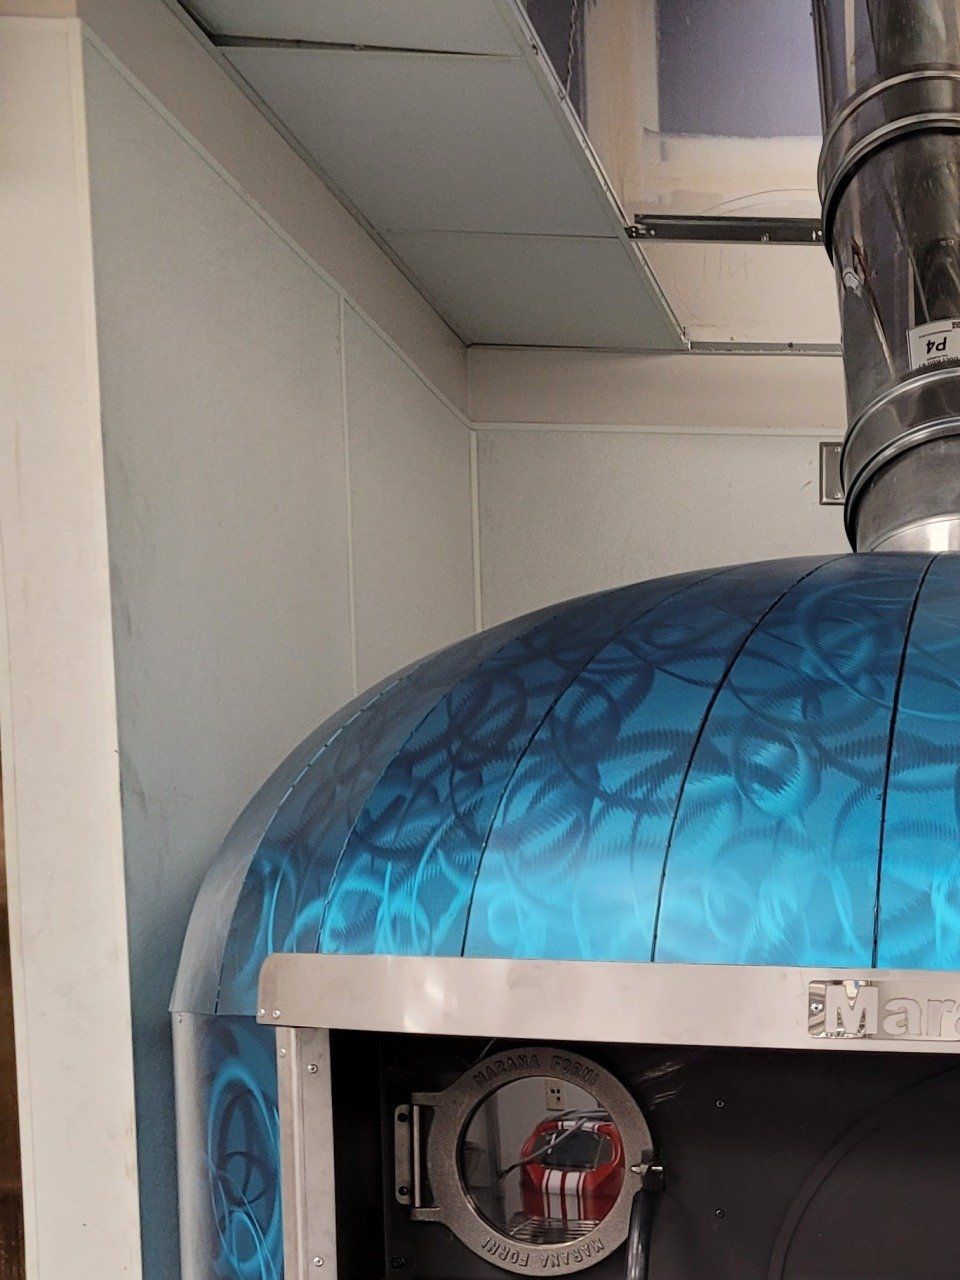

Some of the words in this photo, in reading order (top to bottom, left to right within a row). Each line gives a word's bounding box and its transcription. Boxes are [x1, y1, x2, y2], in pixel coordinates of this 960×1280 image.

[926, 337, 947, 354] P4
[473, 1054, 540, 1088] MARANA
[551, 1055, 599, 1086] FORNI
[481, 1237, 528, 1267] FORNI
[542, 1237, 605, 1269] MARANA
